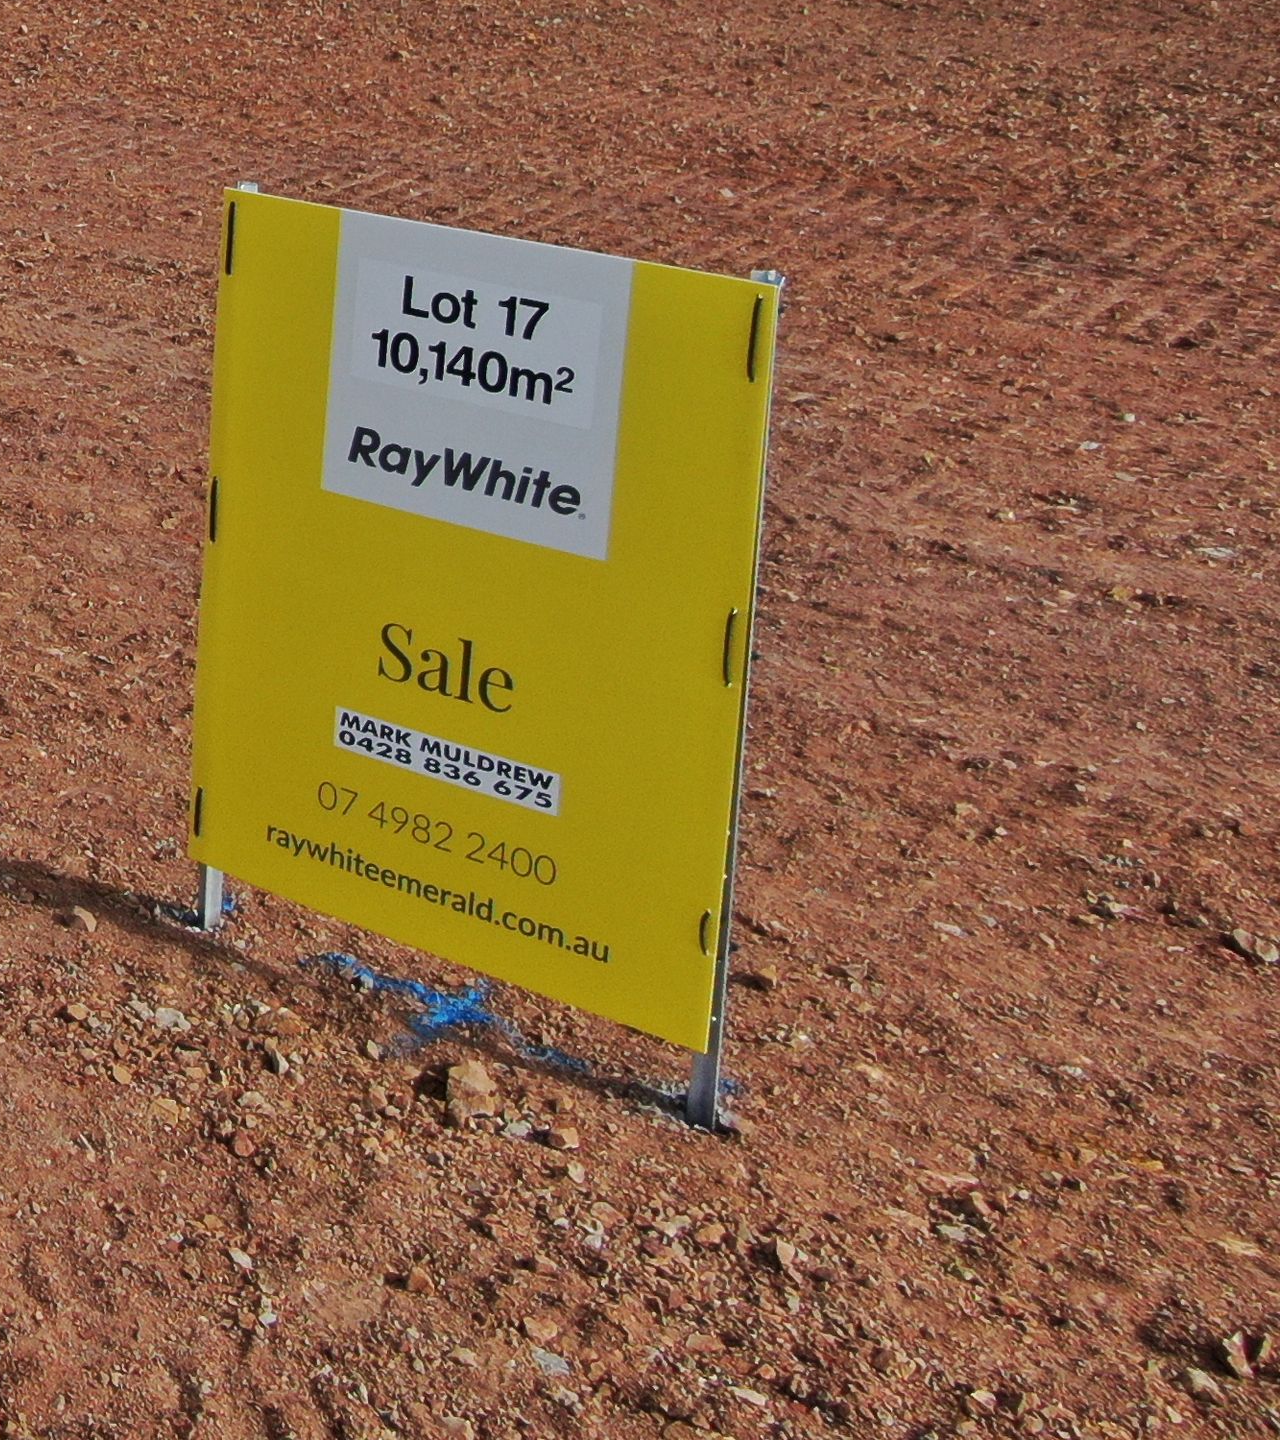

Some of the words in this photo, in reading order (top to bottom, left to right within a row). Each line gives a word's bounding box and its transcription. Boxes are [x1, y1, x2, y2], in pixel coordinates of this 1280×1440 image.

[401, 275, 478, 329] Lot
[498, 296, 550, 340] 17
[347, 426, 582, 516] RayWhite
[377, 622, 514, 713] Sale
[338, 730, 412, 765] 0428
[423, 758, 481, 787] 836
[493, 780, 553, 809] 675
[340, 712, 412, 747] MARK
[420, 737, 554, 790] MULDREW
[317, 781, 358, 816] 07
[367, 801, 454, 853] 4982
[465, 831, 558, 886] 2400
[266, 824, 610, 964] raywhiteemerald.com.au
